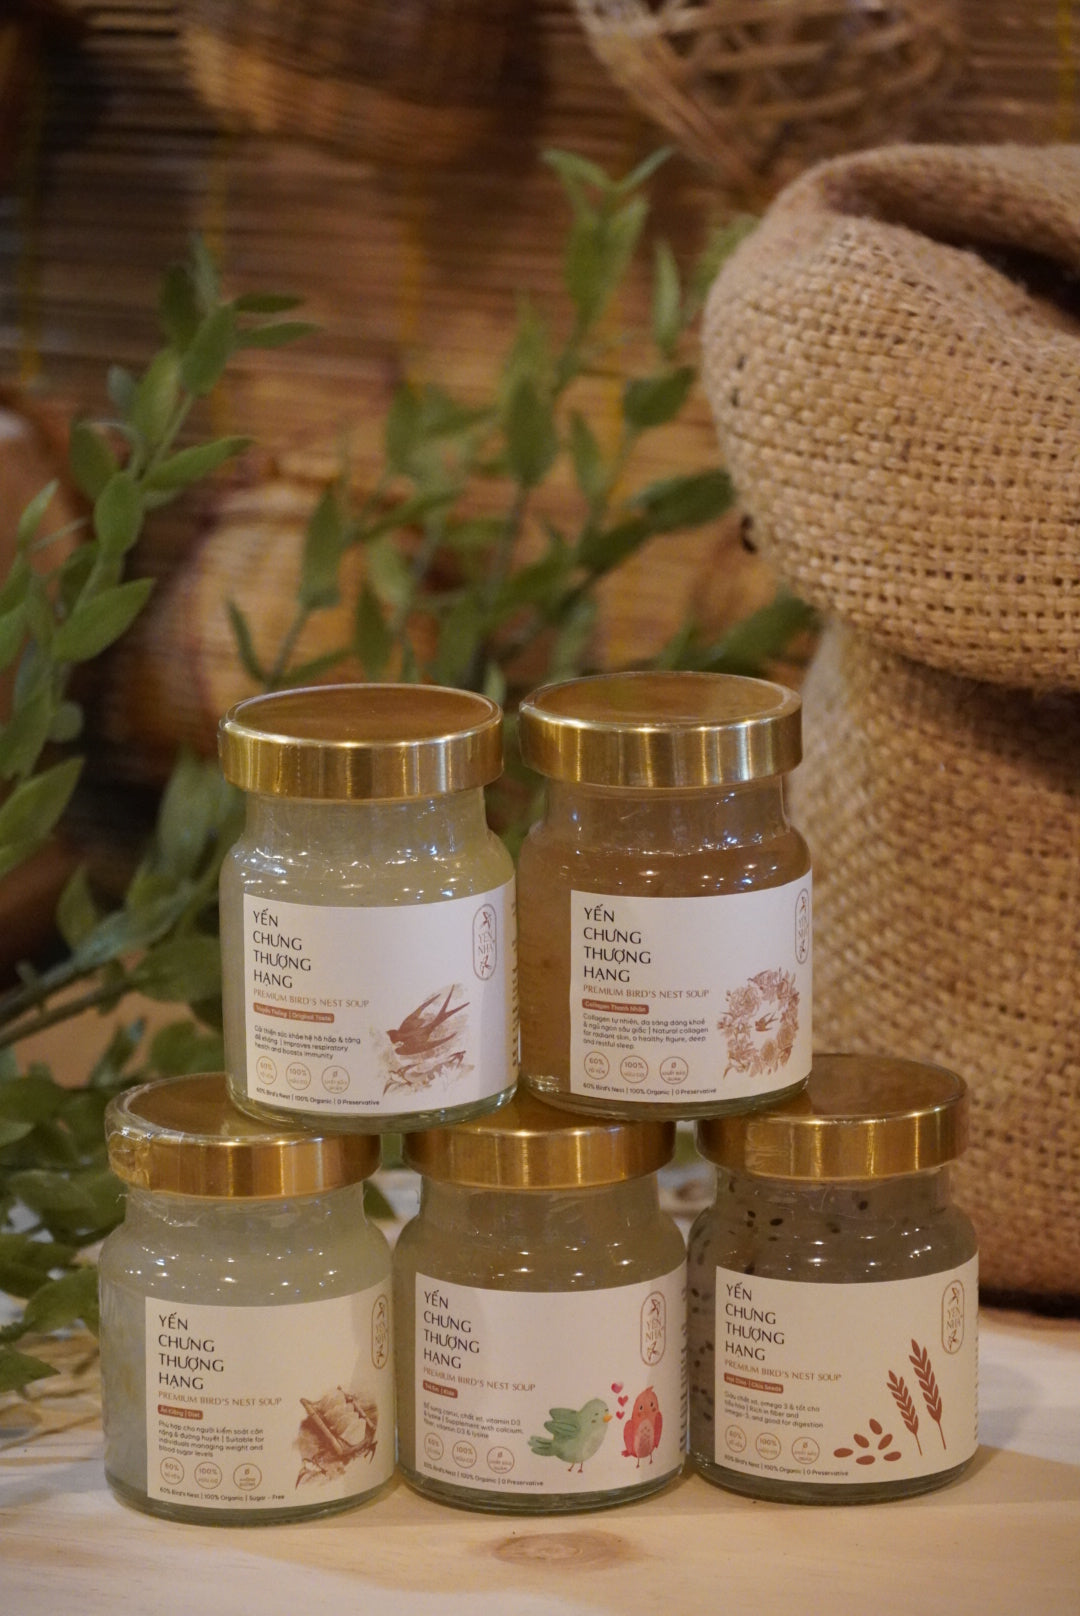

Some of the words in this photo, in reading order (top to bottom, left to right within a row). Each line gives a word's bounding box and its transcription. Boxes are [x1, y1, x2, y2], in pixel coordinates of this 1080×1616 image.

[253, 908, 278, 927] YẾN
[584, 904, 614, 922] YẾN
[253, 931, 302, 950] CHƯNG
[584, 927, 641, 944] CHƯNG
[253, 950, 311, 971] THƯỢNG
[584, 946, 650, 964] THƯỢNG
[254, 969, 292, 988] HẠNG
[584, 966, 629, 982] HẠNG
[254, 988, 287, 1001] PREMIUM
[290, 996, 316, 1005] BIRD'S
[584, 984, 623, 996] PREMIUM
[627, 990, 656, 998] BIRD'S
[583, 1013, 610, 1022] Collagen
[304, 1052, 333, 1060] immunity
[312, 1043, 348, 1052] respiratory
[424, 1290, 448, 1309] YẾN
[726, 1282, 751, 1301] YẾN
[159, 1312, 187, 1330] YẾN
[424, 1311, 471, 1332] CHƯNG
[726, 1303, 776, 1324] CHƯNG
[424, 1329, 479, 1353] THƯỢNG
[726, 1322, 784, 1344] THƯỢNG
[159, 1334, 214, 1352] CHƯNG
[726, 1340, 765, 1360] HẠNG
[158, 1353, 224, 1372] THƯỢNG
[424, 1348, 461, 1368] HẠNG
[424, 1367, 455, 1382] PREMIUM
[458, 1376, 484, 1387] BIRD'S
[487, 1381, 508, 1390] NEST
[513, 1383, 535, 1391] SOUP
[725, 1360, 758, 1373] PREMIUM
[762, 1368, 788, 1378] BIRD'S
[792, 1372, 814, 1380] NEST
[159, 1372, 203, 1390] HẠNG
[159, 1391, 197, 1403] PREMIUM
[793, 1420, 823, 1428] digestion
[191, 1442, 223, 1451] managing
